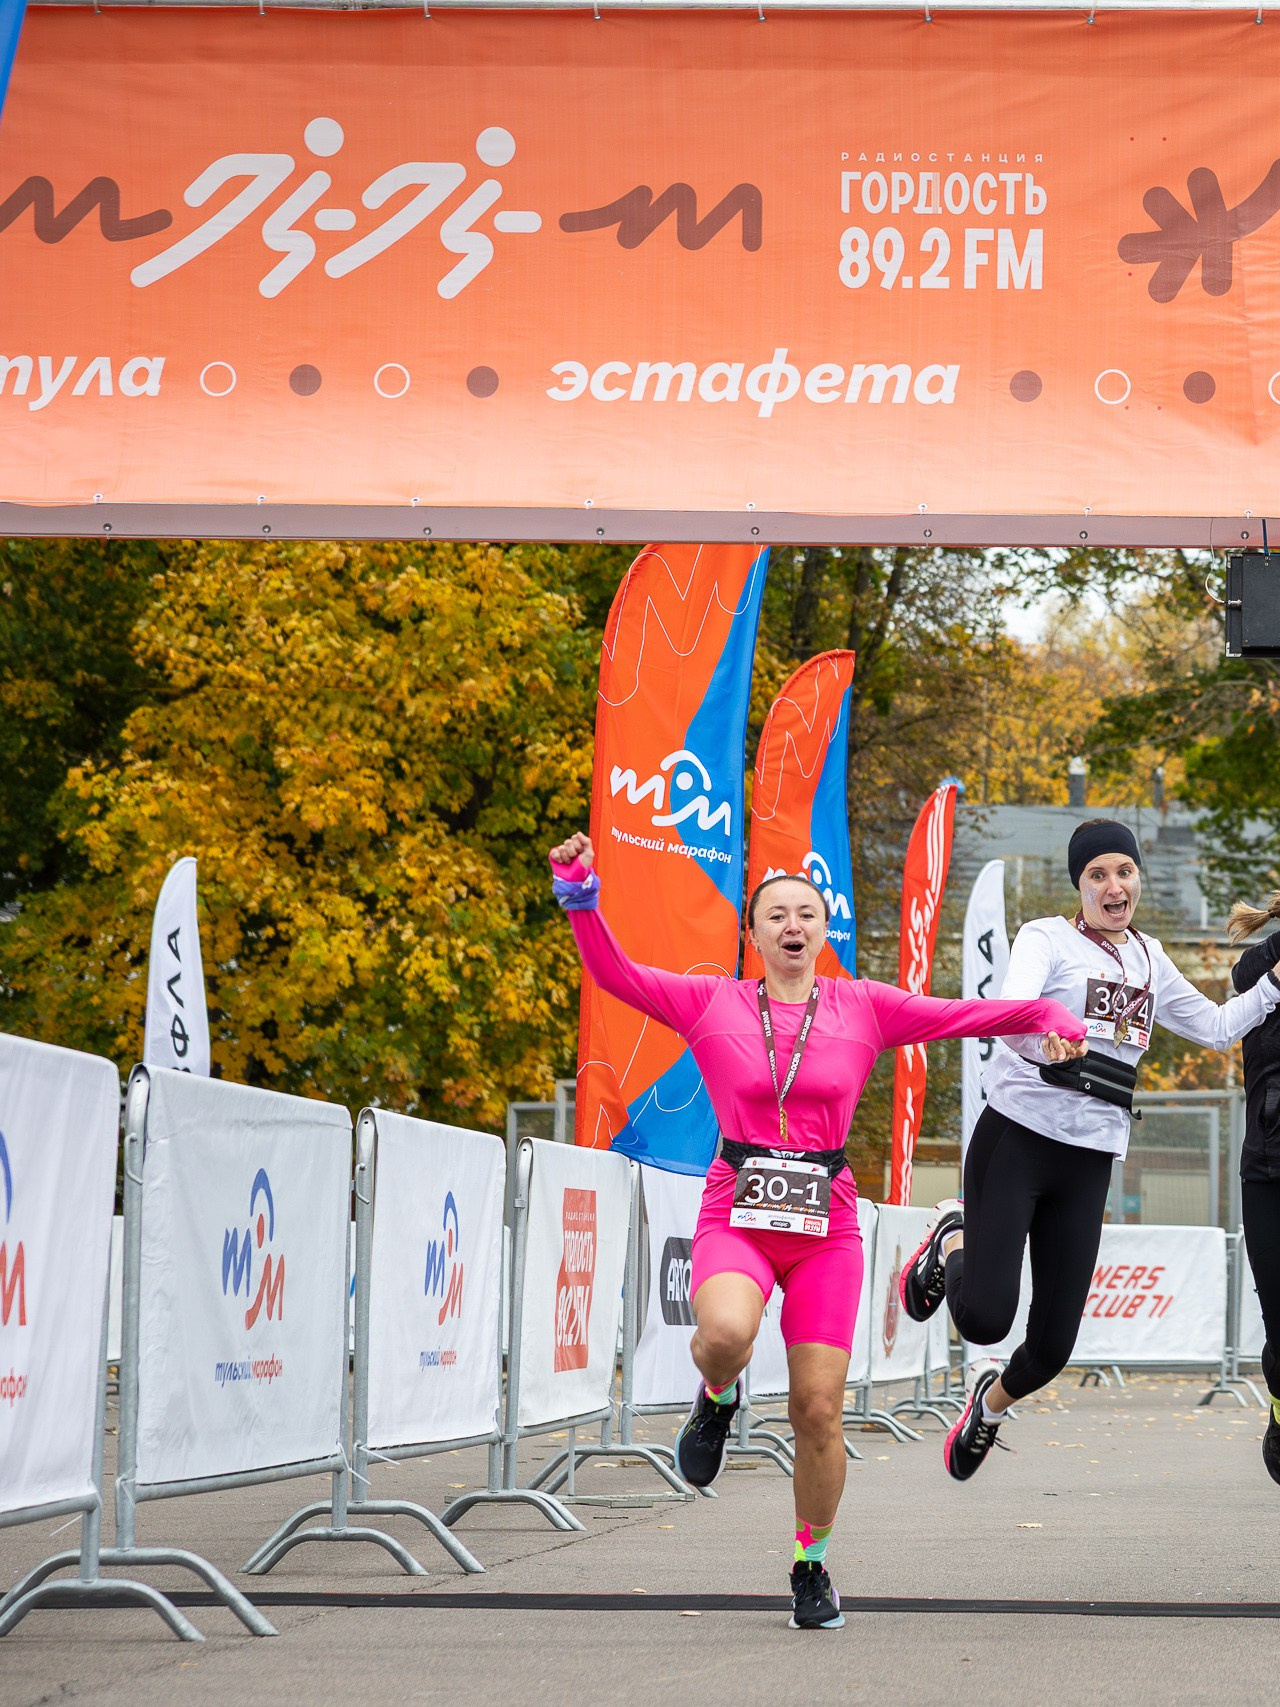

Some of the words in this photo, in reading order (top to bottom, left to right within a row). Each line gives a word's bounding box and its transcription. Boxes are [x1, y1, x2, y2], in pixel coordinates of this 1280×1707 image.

[841, 152, 1043, 164] РАДИОСТАНЦИЯ
[840, 170, 1048, 216] ГОРДОСТЬ
[838, 226, 951, 291] 89.2
[963, 228, 1044, 290] FM
[546, 347, 961, 418] эстафета
[667, 842, 732, 864] марафон
[1093, 986, 1149, 1025] 304
[744, 1173, 821, 1206] 30-1
[1091, 1265, 1166, 1290] NERS
[1148, 1295, 1174, 1318] 71
